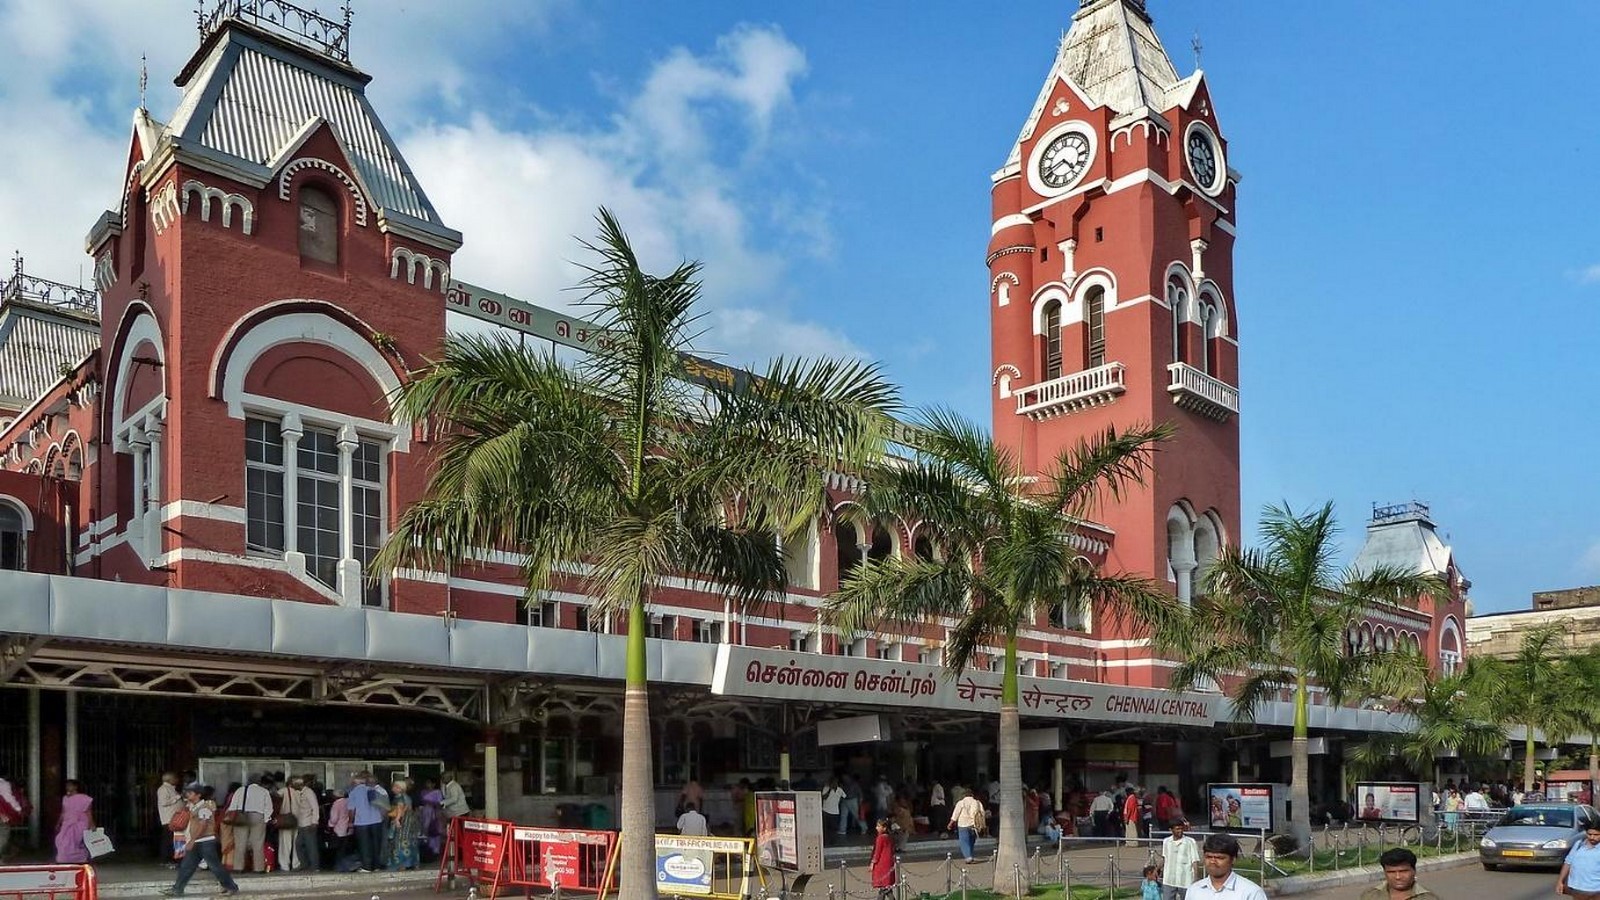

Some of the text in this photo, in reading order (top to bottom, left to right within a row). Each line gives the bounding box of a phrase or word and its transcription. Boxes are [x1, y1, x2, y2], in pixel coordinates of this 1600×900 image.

[746, 659, 937, 698] சென்னை சென்ட்ரல்
[1021, 684, 1094, 713] सेन्ट्रल
[1106, 695, 1208, 718] CHENNAI CENTRAL
